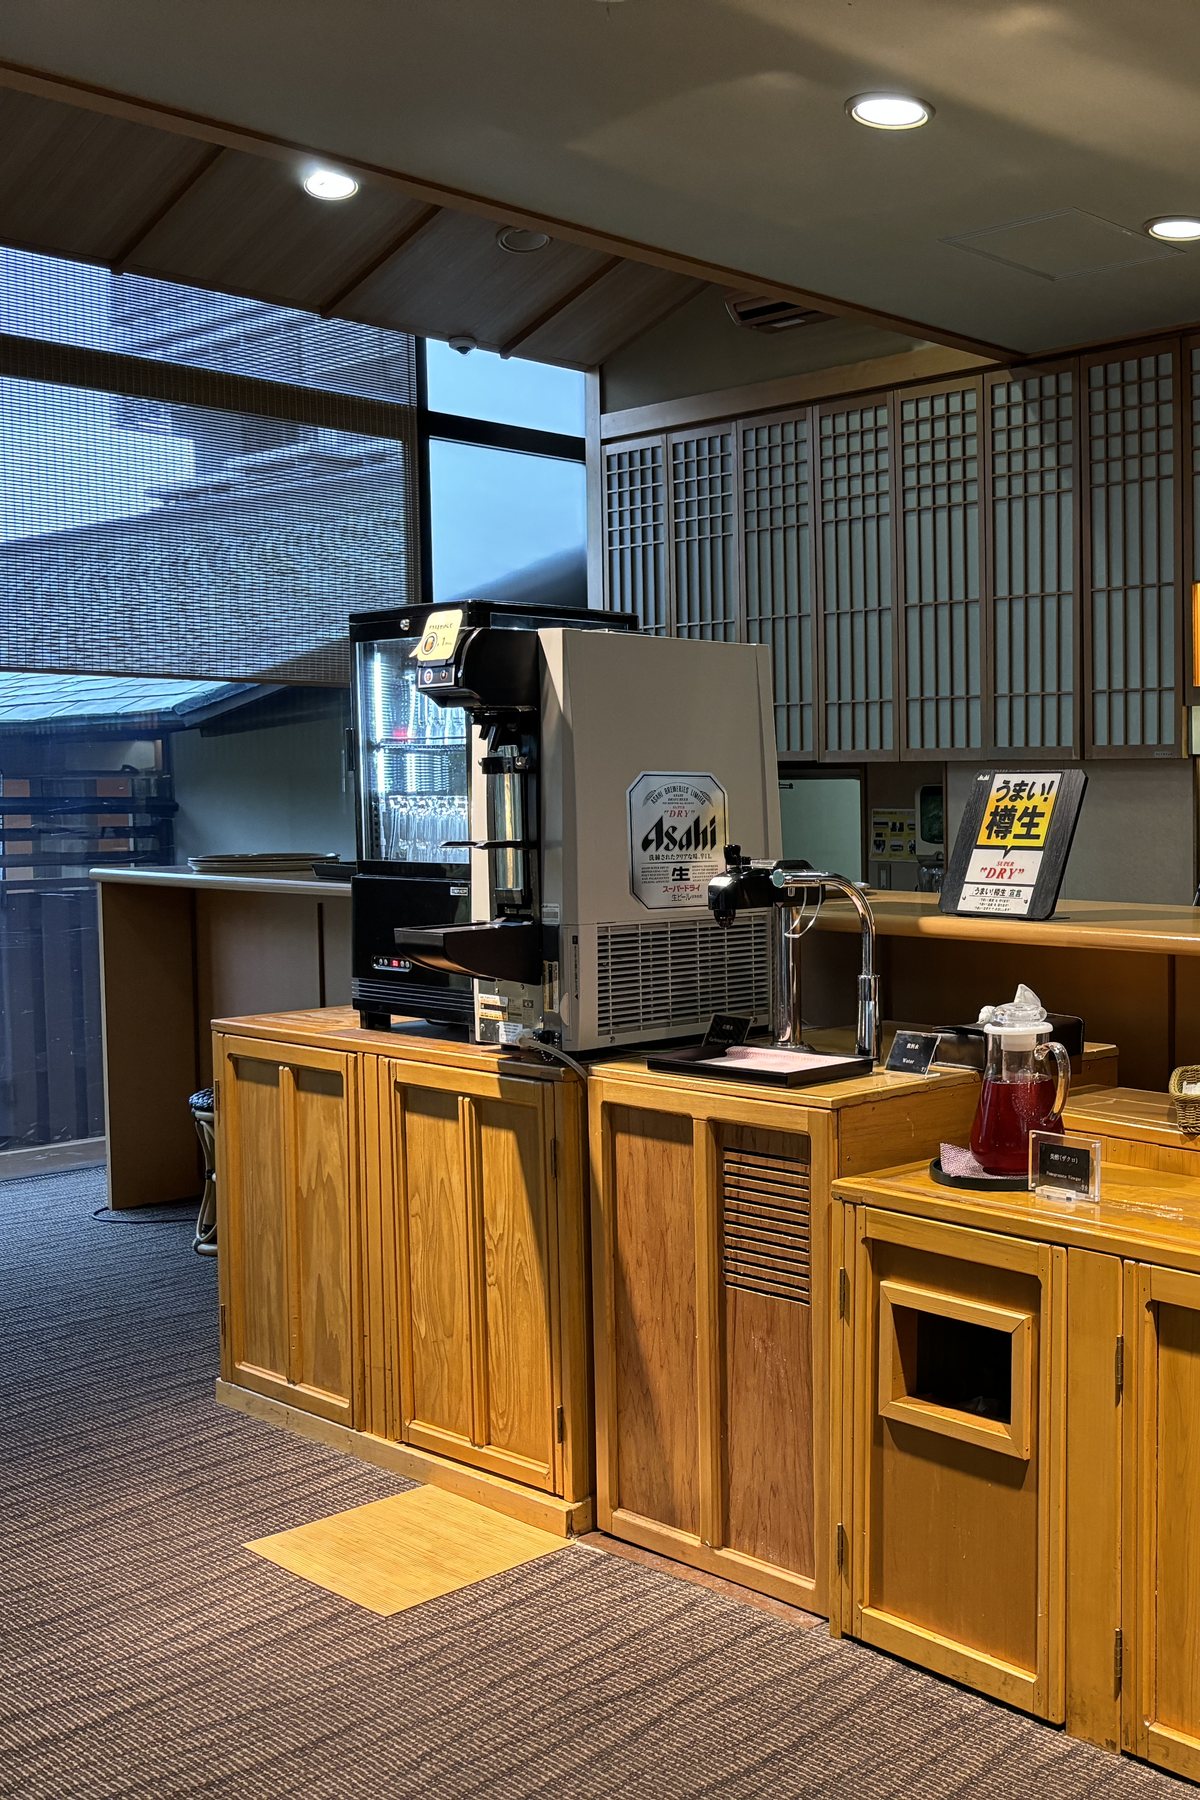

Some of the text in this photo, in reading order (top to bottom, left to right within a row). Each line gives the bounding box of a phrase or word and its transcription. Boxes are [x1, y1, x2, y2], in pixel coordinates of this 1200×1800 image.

[641, 815, 717, 852] Asahi
[985, 805, 1045, 840] 樽生
[672, 866, 690, 881] 生
[662, 884, 700, 893] スーパードライ
